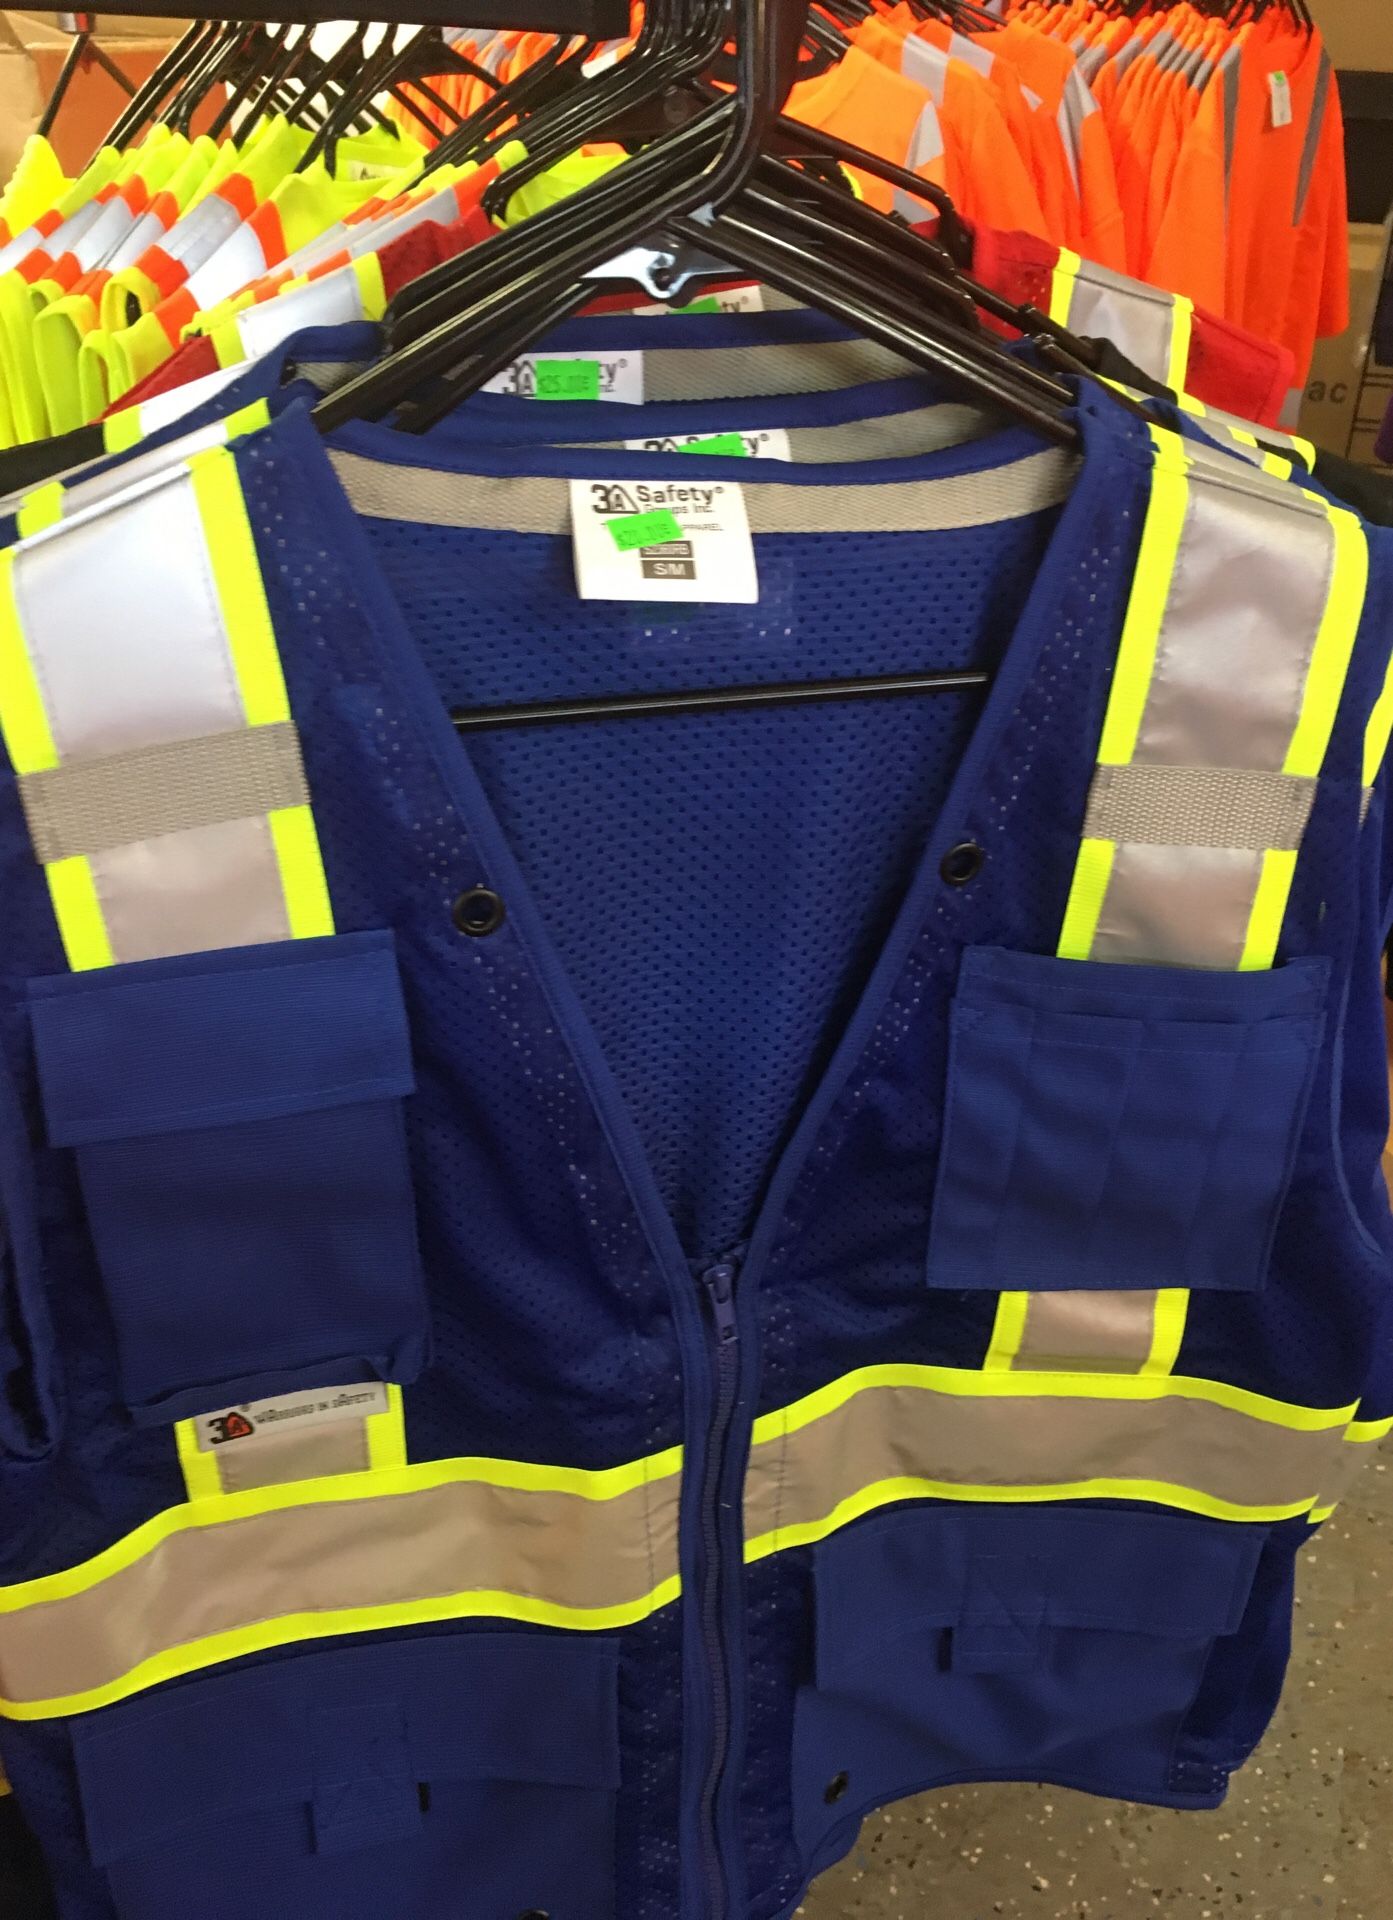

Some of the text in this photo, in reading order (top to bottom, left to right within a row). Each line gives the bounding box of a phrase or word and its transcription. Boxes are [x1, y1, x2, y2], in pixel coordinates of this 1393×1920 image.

[591, 484, 641, 514] 3A
[653, 563, 687, 577] S/M
[207, 1411, 254, 1445] 3A
